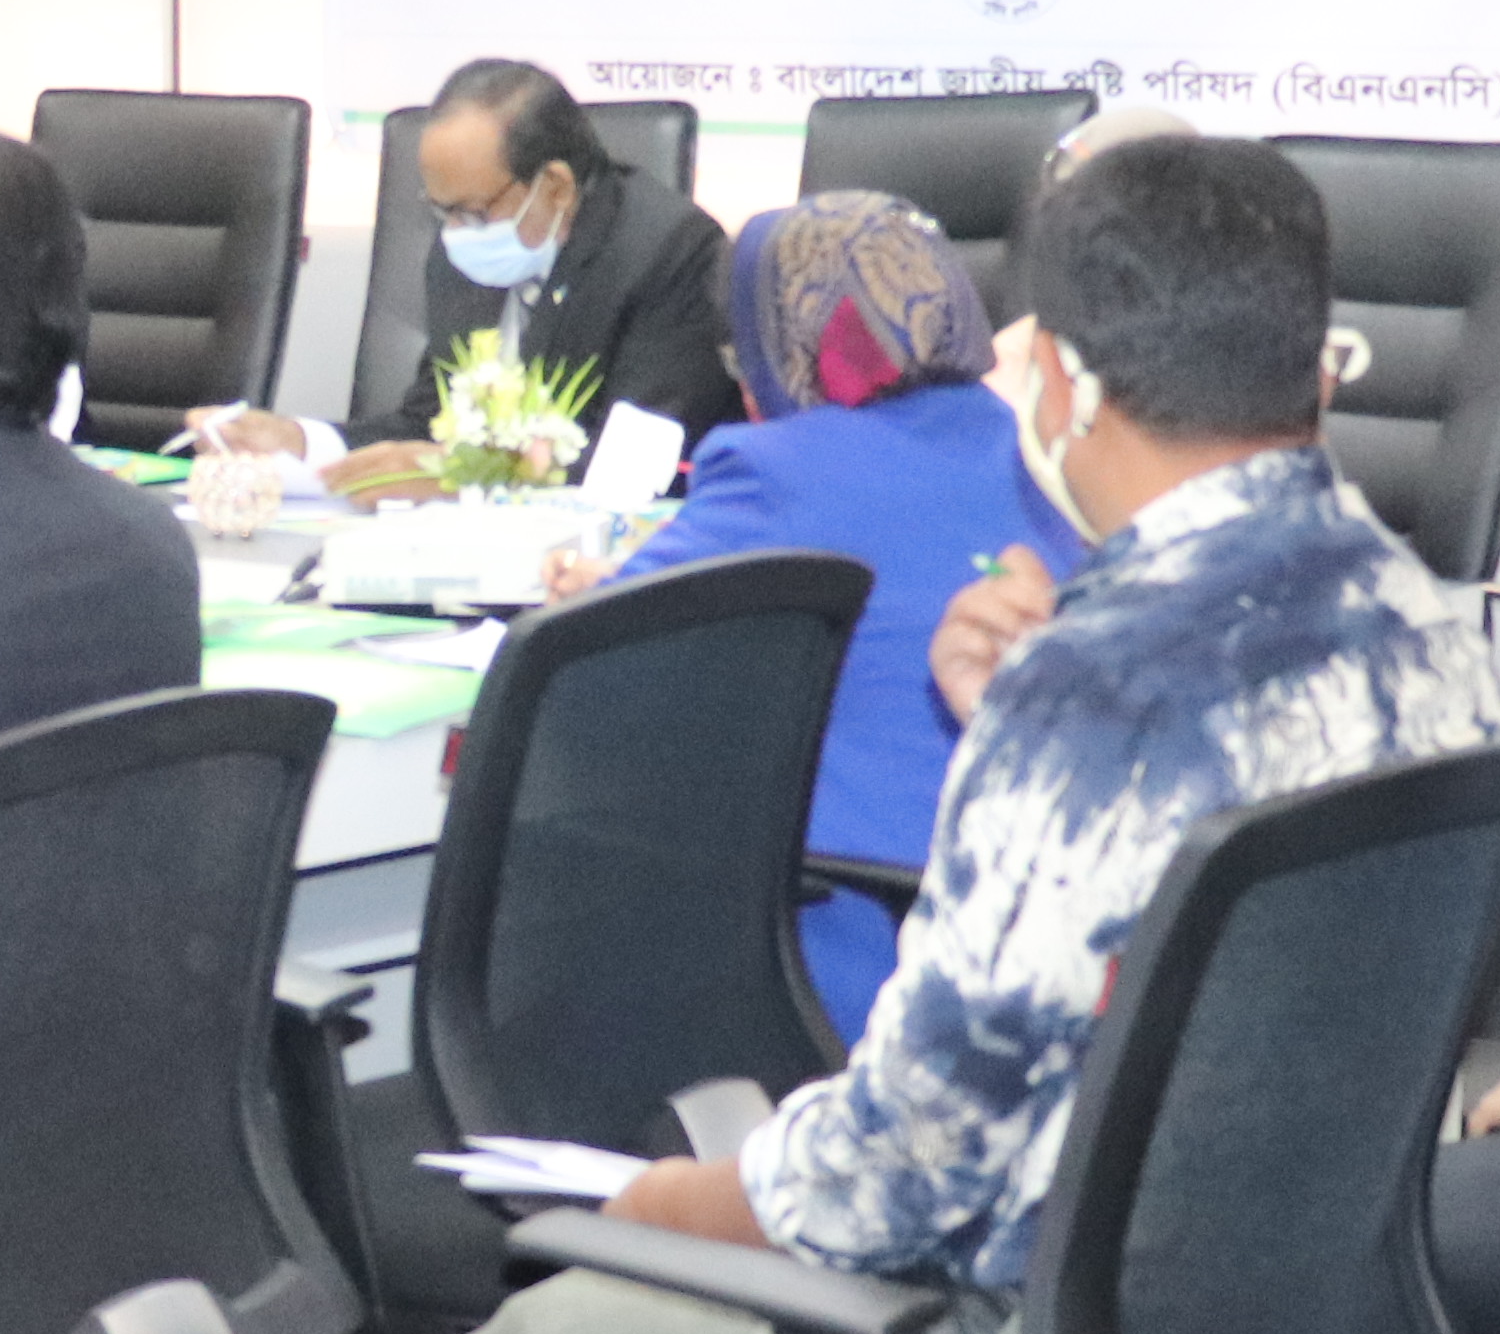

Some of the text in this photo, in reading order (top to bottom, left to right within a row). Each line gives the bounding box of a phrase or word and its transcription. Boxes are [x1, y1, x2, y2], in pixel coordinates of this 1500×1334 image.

[587, 60, 734, 94] আয়োজনে
[776, 64, 925, 97] বাংলাদেশ
[1142, 58, 1257, 105] পরিষদ
